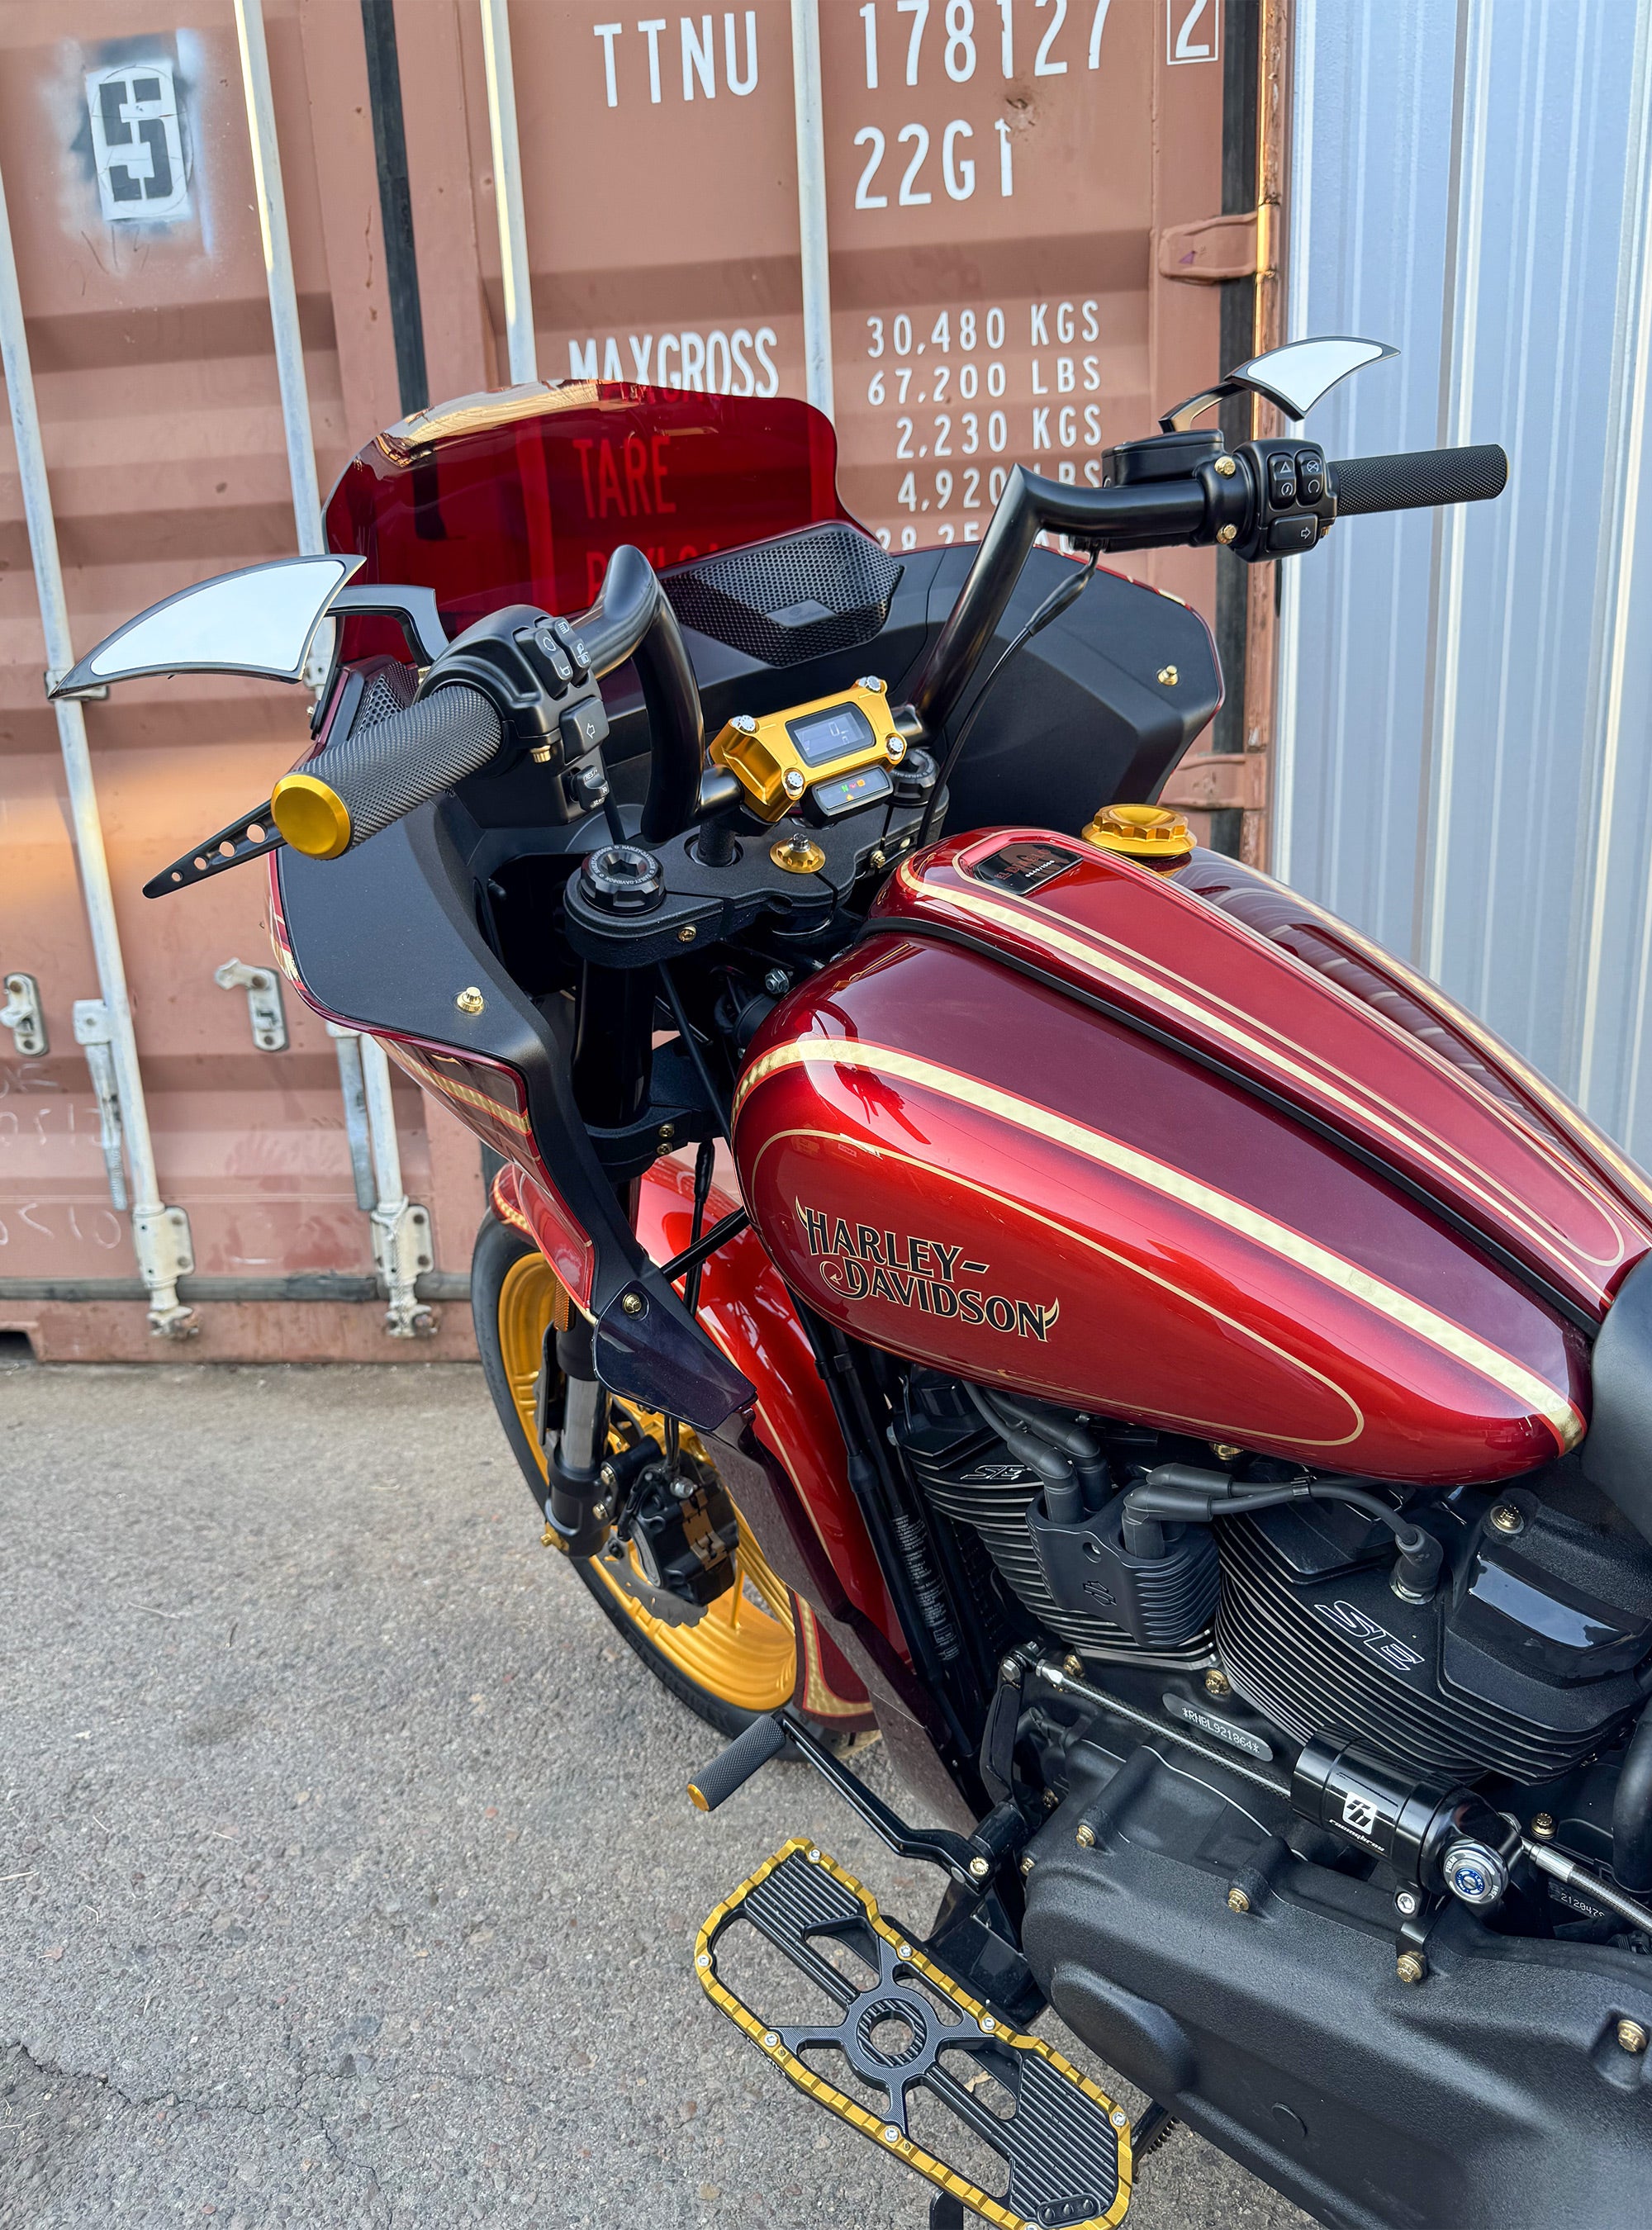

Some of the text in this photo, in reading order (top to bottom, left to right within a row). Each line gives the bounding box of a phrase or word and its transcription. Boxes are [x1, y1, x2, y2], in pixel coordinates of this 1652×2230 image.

[593, 0, 1210, 107] TTNU 178127 2
[853, 118, 1014, 209] 22G1
[866, 300, 1099, 358] 30,480 KGS
[867, 355, 1101, 406] 67,200 LBS
[895, 404, 1102, 459] 2,230 KGS
[572, 435, 677, 519] TARE
[897, 466, 1008, 512] 4,920
[795, 1195, 990, 1282] HARLEY-
[819, 1255, 1061, 1342] DAVIDSON
[1313, 1600, 1426, 1671] SE
[1445, 1855, 1458, 1873] FIRM
[1488, 1884, 1499, 1900] HSC
